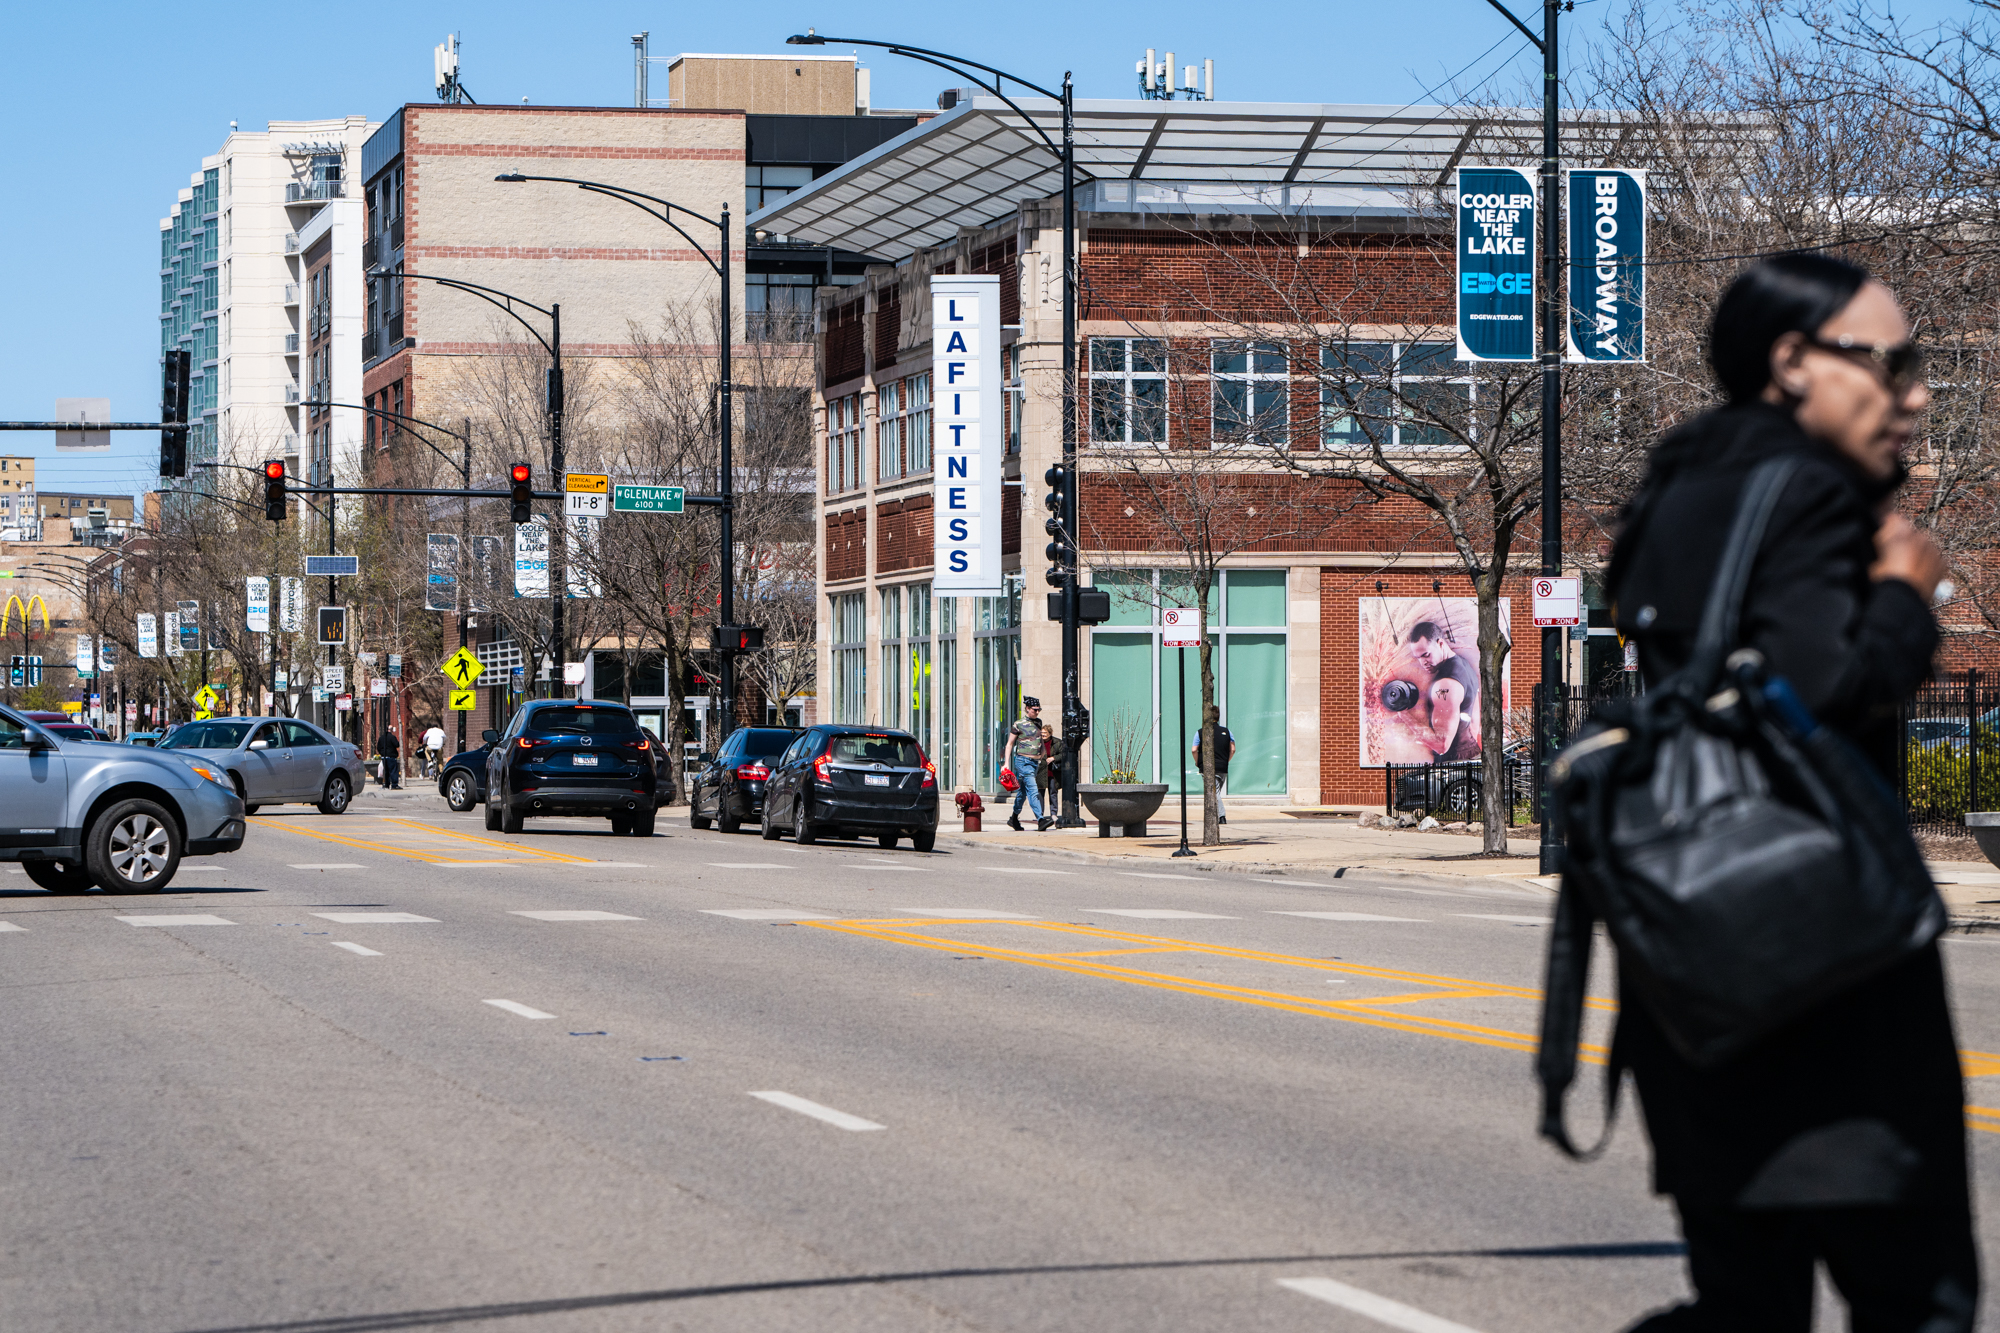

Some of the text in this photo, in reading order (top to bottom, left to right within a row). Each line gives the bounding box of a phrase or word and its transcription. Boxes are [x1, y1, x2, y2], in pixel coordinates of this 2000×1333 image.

[1460, 194, 1532, 209] COOLER
[1473, 210, 1519, 223] NEAR
[1480, 223, 1513, 237] THE
[1468, 237, 1525, 254] LAKE
[1595, 176, 1618, 356] BROADWAY
[1461, 272, 1531, 294] EDGE
[624, 489, 672, 500] GLENLAKE
[516, 560, 548, 570] EDGE
[326, 679, 342, 689] 25
